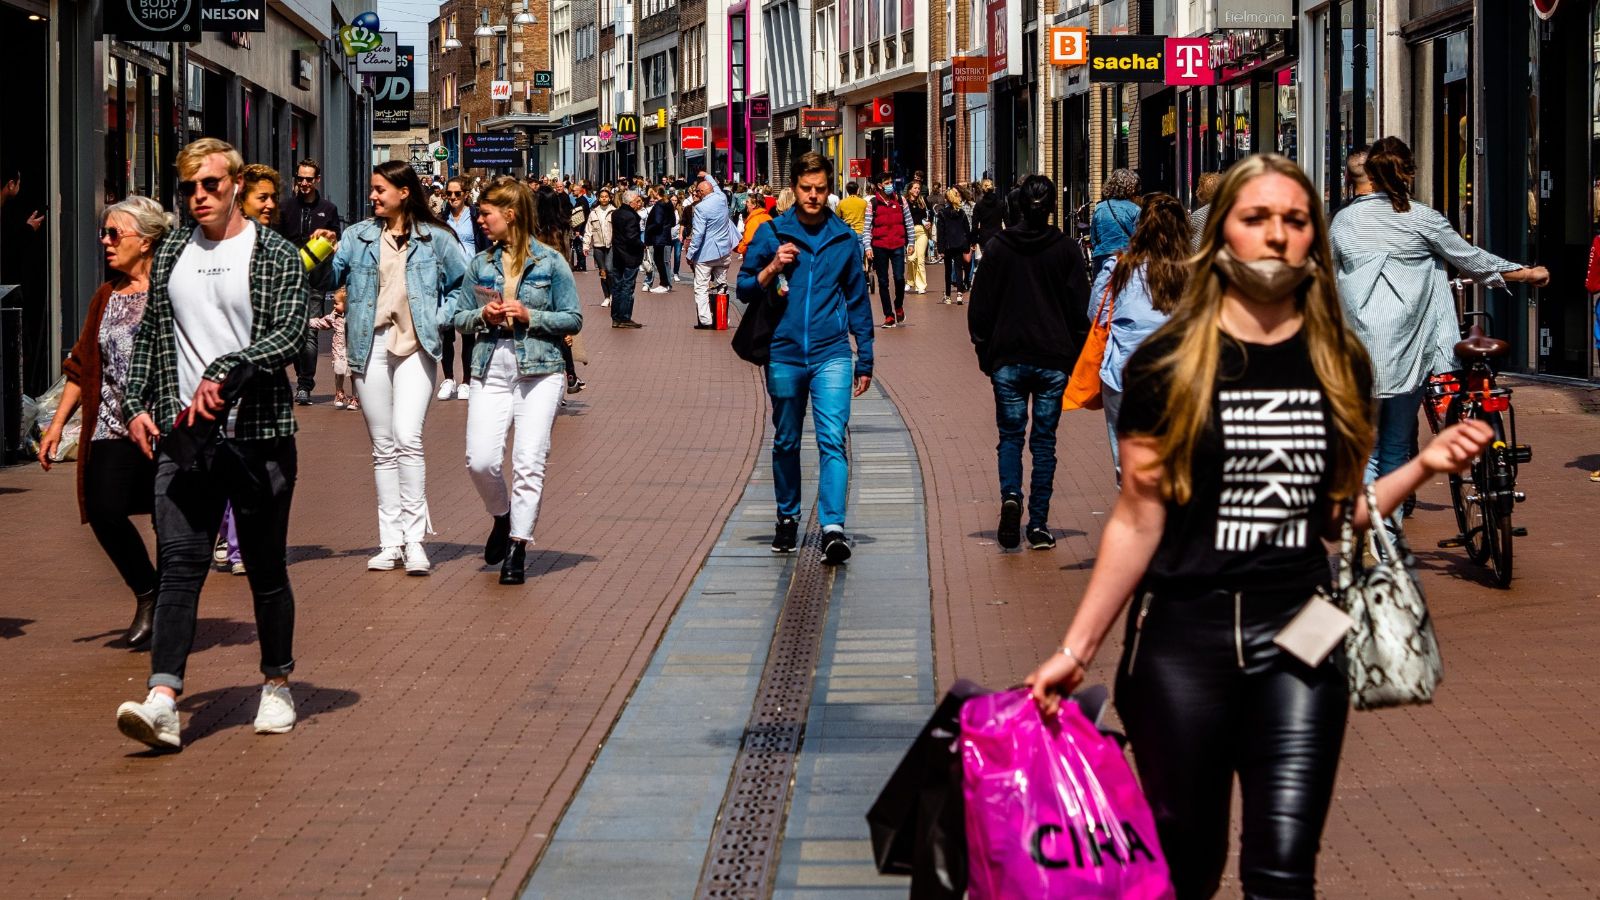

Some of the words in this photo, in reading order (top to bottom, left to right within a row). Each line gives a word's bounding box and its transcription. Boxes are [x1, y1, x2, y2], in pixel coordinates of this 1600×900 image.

[139, 0, 178, 8] BODY
[141, 9, 177, 19] SHOP
[201, 9, 259, 20] NELSON
[1060, 36, 1077, 55] B
[363, 53, 393, 64] Etam
[1093, 54, 1159, 70] sacha
[1176, 45, 1203, 78] T
[955, 67, 986, 75] DISTRIKT
[375, 77, 411, 100] JD
